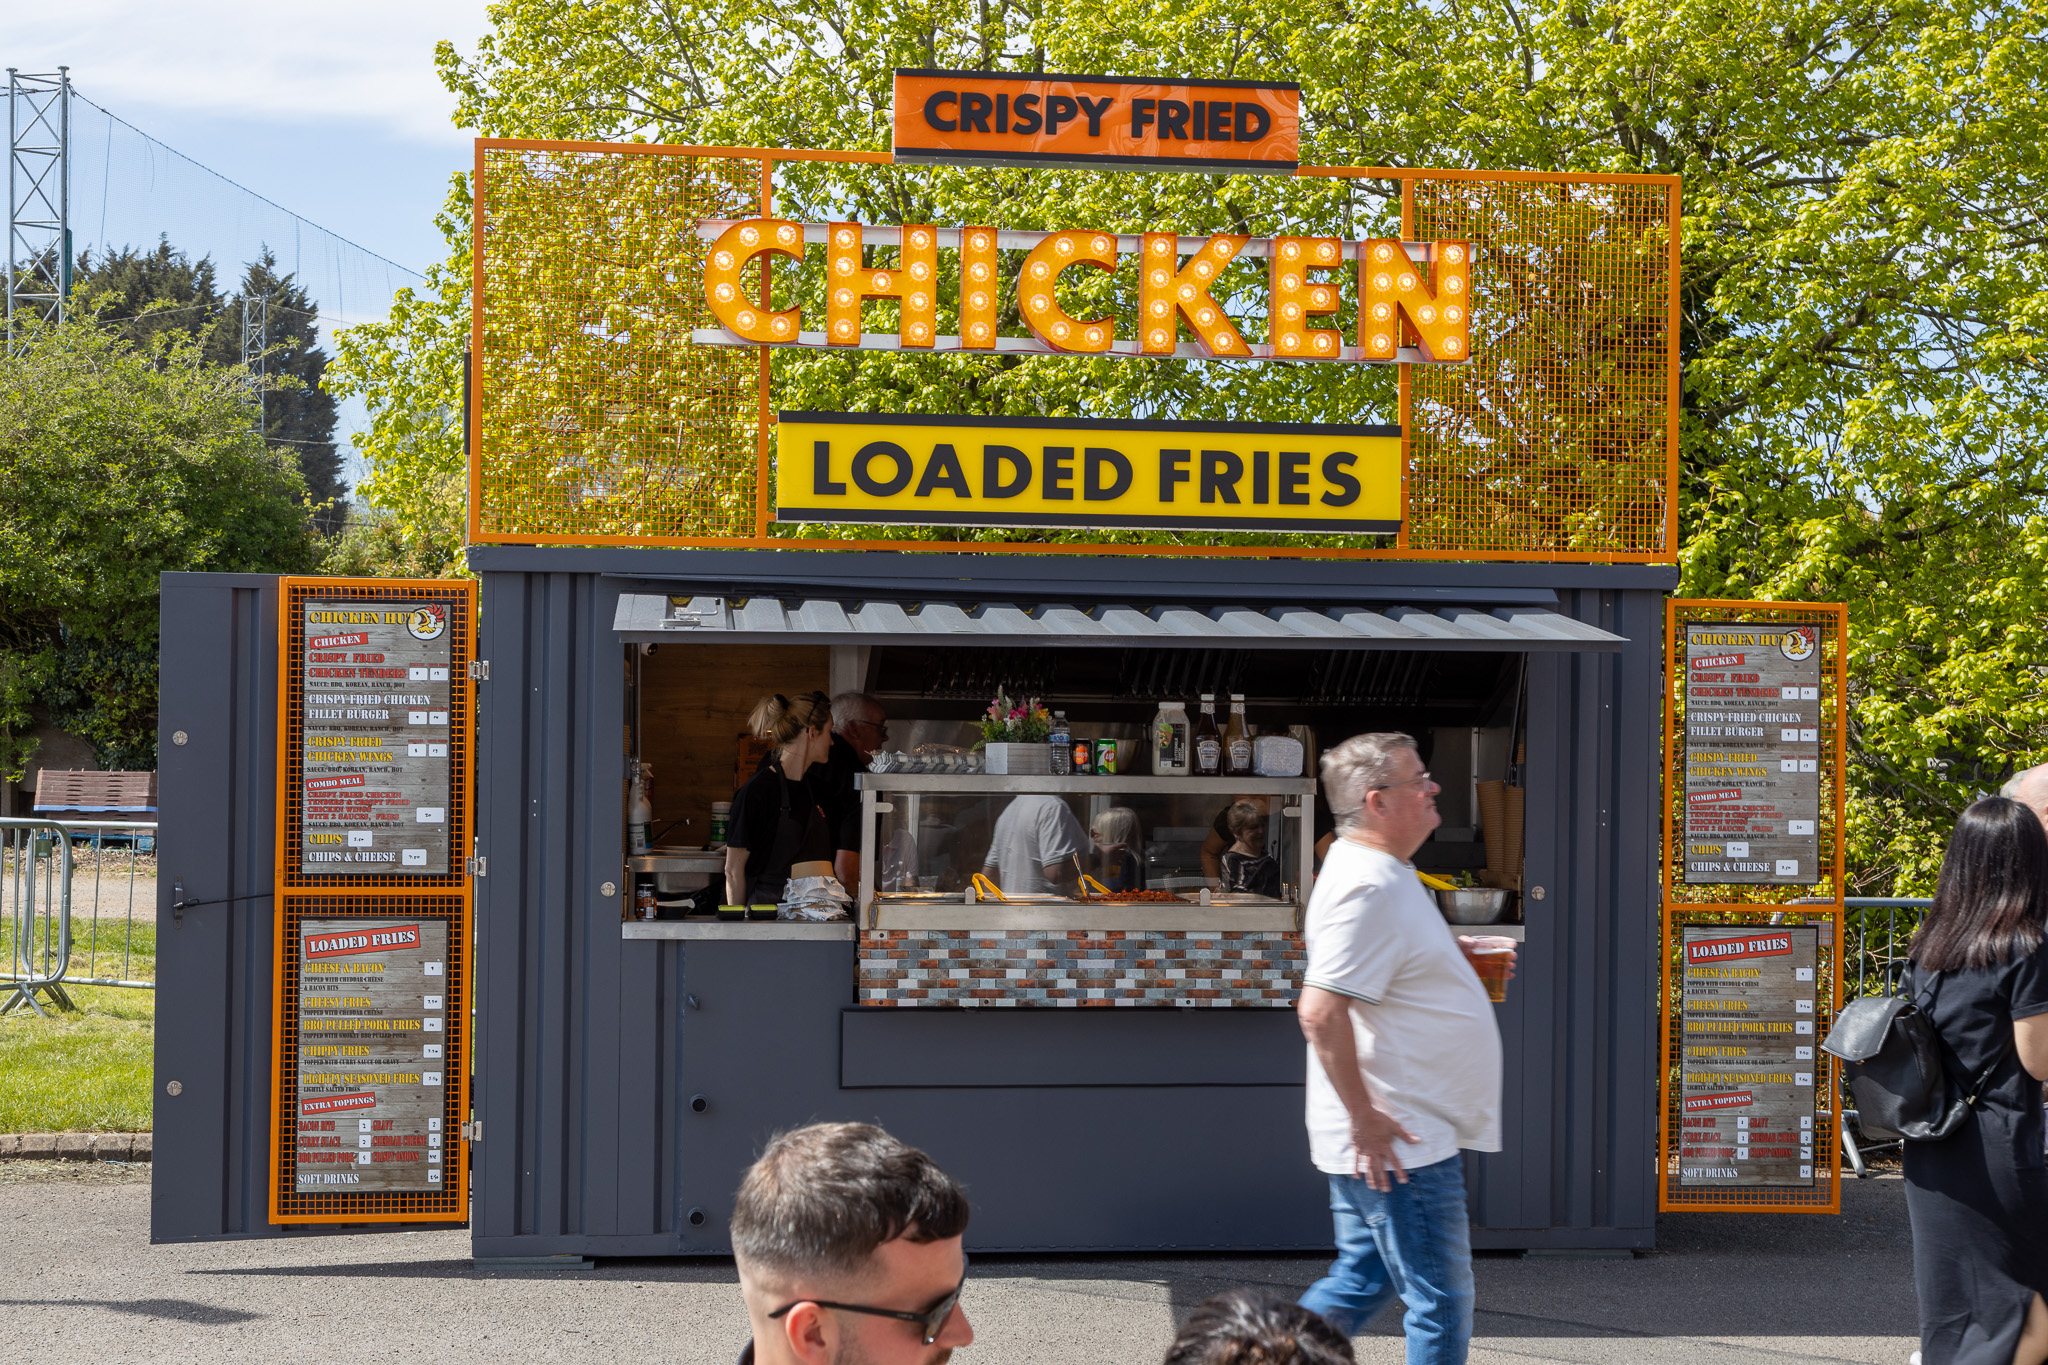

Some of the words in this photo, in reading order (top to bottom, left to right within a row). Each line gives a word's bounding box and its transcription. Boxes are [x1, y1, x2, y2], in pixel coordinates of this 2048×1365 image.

[923, 91, 1113, 137] CRISPY
[1130, 99, 1271, 143] FRIED
[704, 219, 1471, 363] CHICKEN
[812, 441, 1133, 502] LOADED
[1159, 449, 1362, 507] FRIES
[310, 612, 379, 624] CHICKEN
[384, 612, 417, 625] HUT
[314, 635, 360, 647] CHICKEN
[1692, 634, 1755, 646] CHICKEN
[1759, 635, 1789, 646] HUT
[309, 653, 347, 663] CRISPY
[353, 653, 385, 663] FRIED
[1696, 656, 1738, 668] CHICKEN
[309, 668, 355, 678] CHICKEN
[358, 669, 406, 678] TENDERS
[1691, 673, 1726, 682] CRISPY
[1731, 674, 1760, 683] FRIED
[1691, 688, 1733, 697] CHICKEN
[1736, 688, 1779, 697] TENDERS
[308, 695, 347, 704] CRISPY
[350, 695, 381, 705] FRIED
[384, 695, 431, 705] CHICKEN
[308, 710, 344, 719] FILLET
[347, 710, 389, 720] BURGER
[1691, 713, 1726, 722] CRISPY
[1728, 713, 1757, 723] FRIED
[1759, 713, 1801, 723] CHICKEN
[1691, 727, 1722, 736] FILLET
[1725, 727, 1764, 736] BURGER
[308, 737, 347, 747] CRISPY
[350, 737, 382, 747] FRIED
[308, 752, 356, 762] CHICKEN
[359, 753, 393, 762] WINGS
[1098, 745, 1111, 766] 7
[1690, 753, 1725, 762] CRISPY
[1728, 753, 1757, 762] FRIED
[1690, 767, 1734, 776] CHICKEN
[1737, 768, 1767, 777] WINGS
[308, 780, 338, 788] COMBO
[339, 778, 362, 786] MEAL
[1690, 794, 1717, 802] COMBO
[309, 834, 342, 844] CHIPS
[1691, 845, 1722, 854] CHIPS
[308, 852, 342, 862] CHIPS
[344, 852, 352, 862] &
[354, 852, 396, 862] CHEESE
[1691, 862, 1721, 871] CHIPS
[1723, 862, 1731, 871] &
[1733, 862, 1770, 872] CHEESE
[309, 936, 368, 953] LOADED
[371, 930, 416, 946] FRIES
[1692, 942, 1745, 958] LOADED
[1748, 938, 1788, 952] FRIES
[305, 963, 341, 973] CHEESE
[343, 963, 350, 973] &
[353, 963, 385, 973] BACON
[1687, 968, 1720, 978] CHEESE
[1722, 968, 1729, 978] &
[1732, 968, 1760, 978] BACON
[304, 997, 340, 1007] CHEESY
[344, 997, 371, 1007] FRIES
[1687, 1000, 1720, 1010] CHEESY
[1723, 1001, 1748, 1010] FRIES
[304, 1020, 323, 1030] BBQ
[326, 1020, 361, 1030] PULLED
[364, 1020, 390, 1030] PORK
[393, 1020, 420, 1030] FRIES
[1687, 1022, 1704, 1032] BBQ
[1707, 1022, 1739, 1032] PULLED
[1741, 1022, 1765, 1032] PORK
[1768, 1023, 1793, 1032] FRIES
[304, 1046, 339, 1056] CHIPPY
[342, 1046, 370, 1056] FRIES
[1687, 1047, 1720, 1056] CHIPPY
[1722, 1047, 1747, 1056] FRIES
[303, 1074, 342, 1084] LIGHTLY
[344, 1074, 391, 1084] SEASONED
[393, 1074, 420, 1084] FRIES
[1686, 1073, 1722, 1083] LIGHTLY
[1724, 1073, 1766, 1083] SEASONED
[1768, 1074, 1792, 1084] FRIES
[304, 1102, 331, 1111] EXTRA
[333, 1096, 374, 1107] TOPPINGS
[1687, 1100, 1712, 1108] EXTRA
[1713, 1095, 1751, 1105] TOPPINGS
[299, 1121, 319, 1131] BACON
[321, 1121, 335, 1131] BITS
[372, 1120, 393, 1130] GRAVY
[299, 1136, 320, 1147] CURRY
[372, 1136, 401, 1146] CHEDDAR
[402, 1136, 426, 1146] CHEESE
[298, 1152, 311, 1162] BBQ
[312, 1153, 336, 1163] PULLED
[337, 1153, 354, 1162] PORK
[372, 1151, 394, 1162] CRISPY
[395, 1152, 419, 1161] ONIONS
[1683, 1168, 1704, 1178] SOFT
[1706, 1168, 1738, 1178] DRINKS
[298, 1174, 321, 1184] SOFT
[324, 1174, 359, 1184] DRINKS
